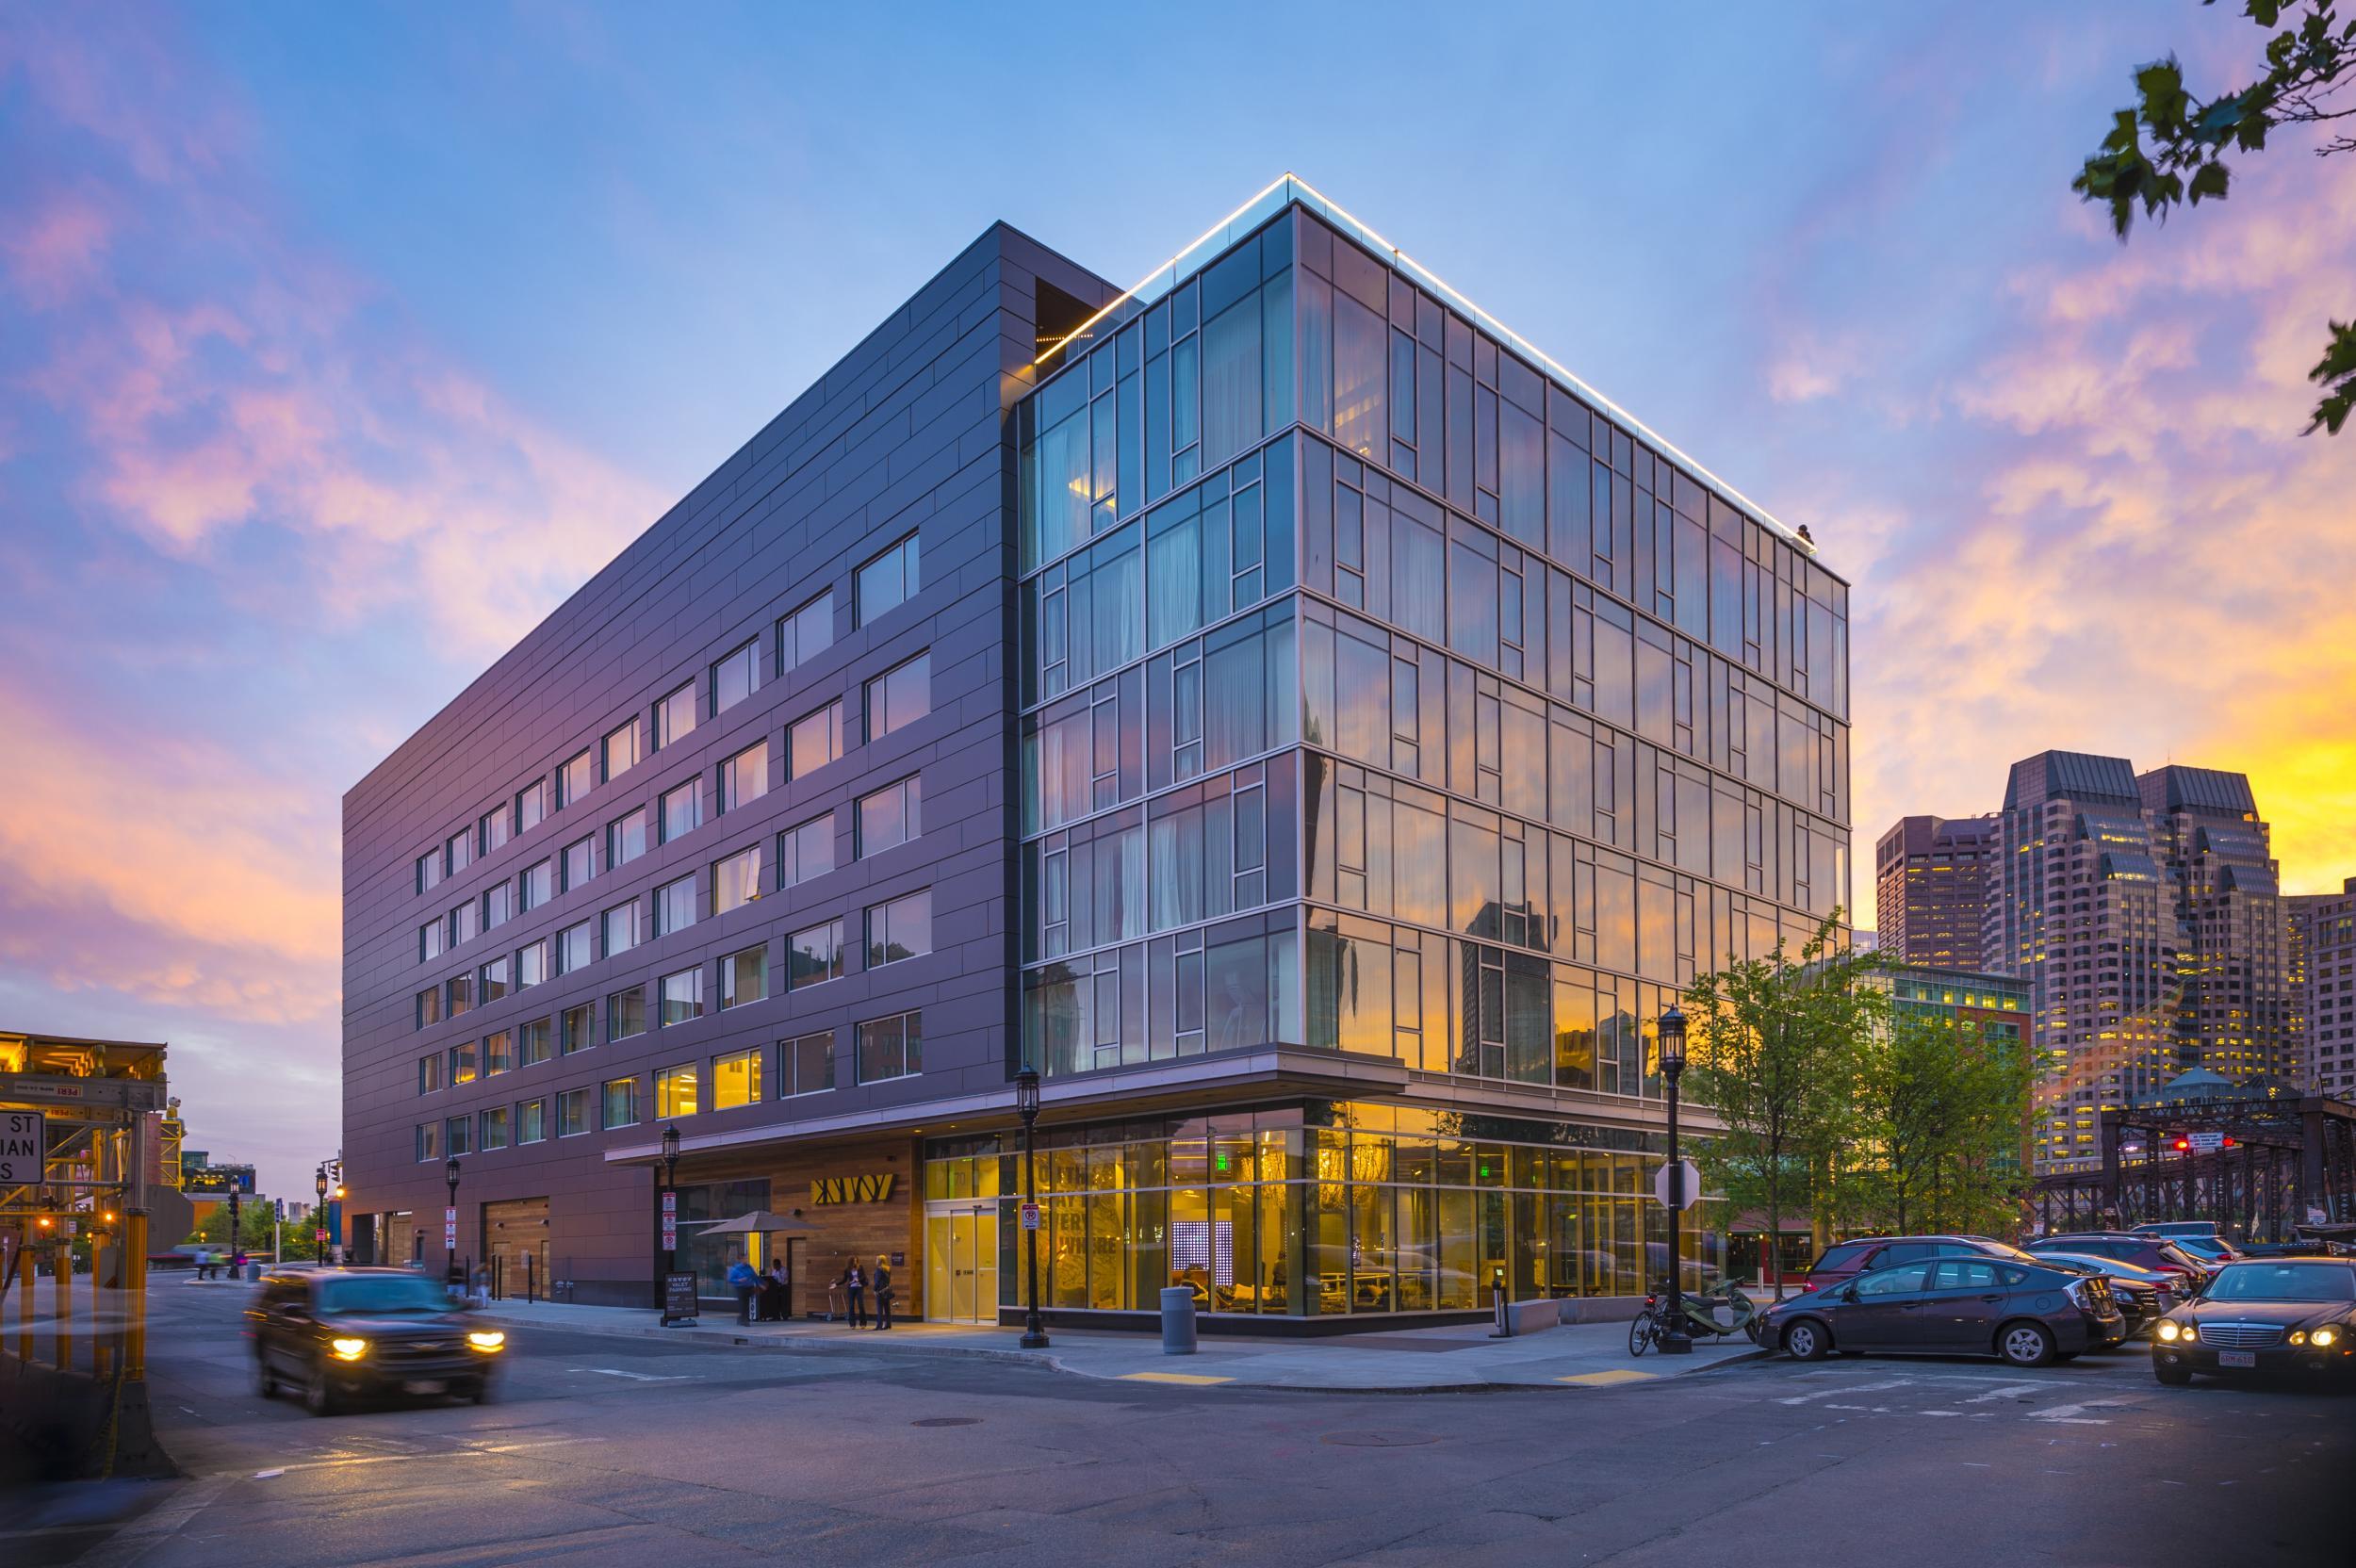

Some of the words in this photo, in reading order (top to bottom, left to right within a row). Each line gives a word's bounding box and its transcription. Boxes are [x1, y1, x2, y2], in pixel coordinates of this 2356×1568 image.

[57, 1087, 78, 1096] PERI
[10, 1115, 34, 1133] ST
[955, 1171, 966, 1185] 70
[810, 1173, 896, 1205] ENVOY
